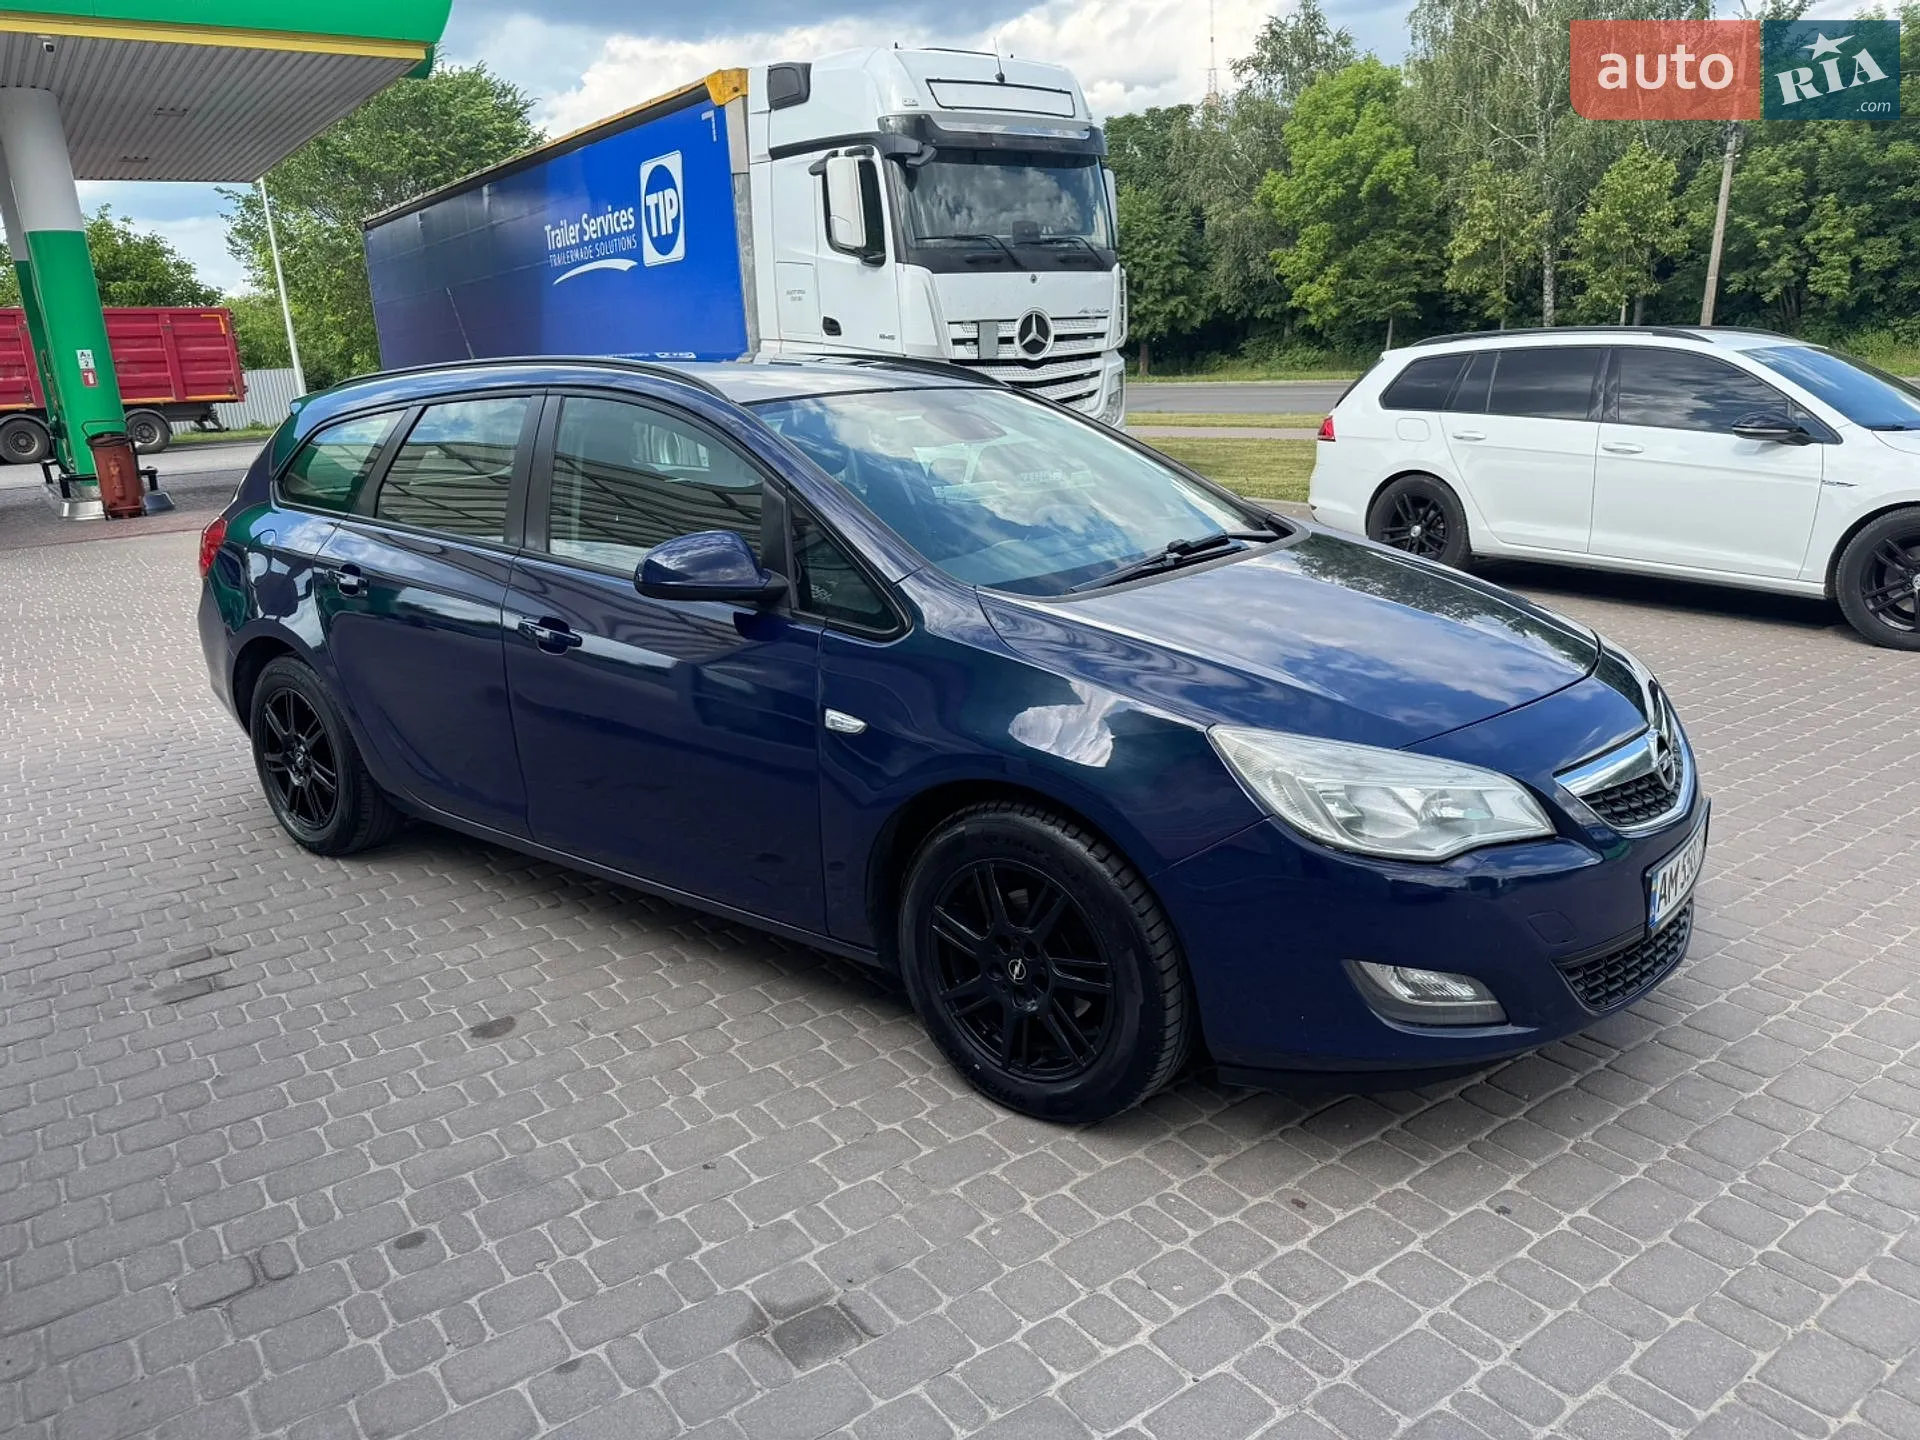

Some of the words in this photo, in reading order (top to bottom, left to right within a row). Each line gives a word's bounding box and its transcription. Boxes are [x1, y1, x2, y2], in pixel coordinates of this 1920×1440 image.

[544, 220, 580, 250] Trailer
[582, 205, 635, 241] Services
[646, 188, 679, 238] TIP
[549, 244, 594, 268] TRAILERMADE
[594, 233, 638, 258] SOLUTIONS
[1657, 860, 1680, 913] AM
